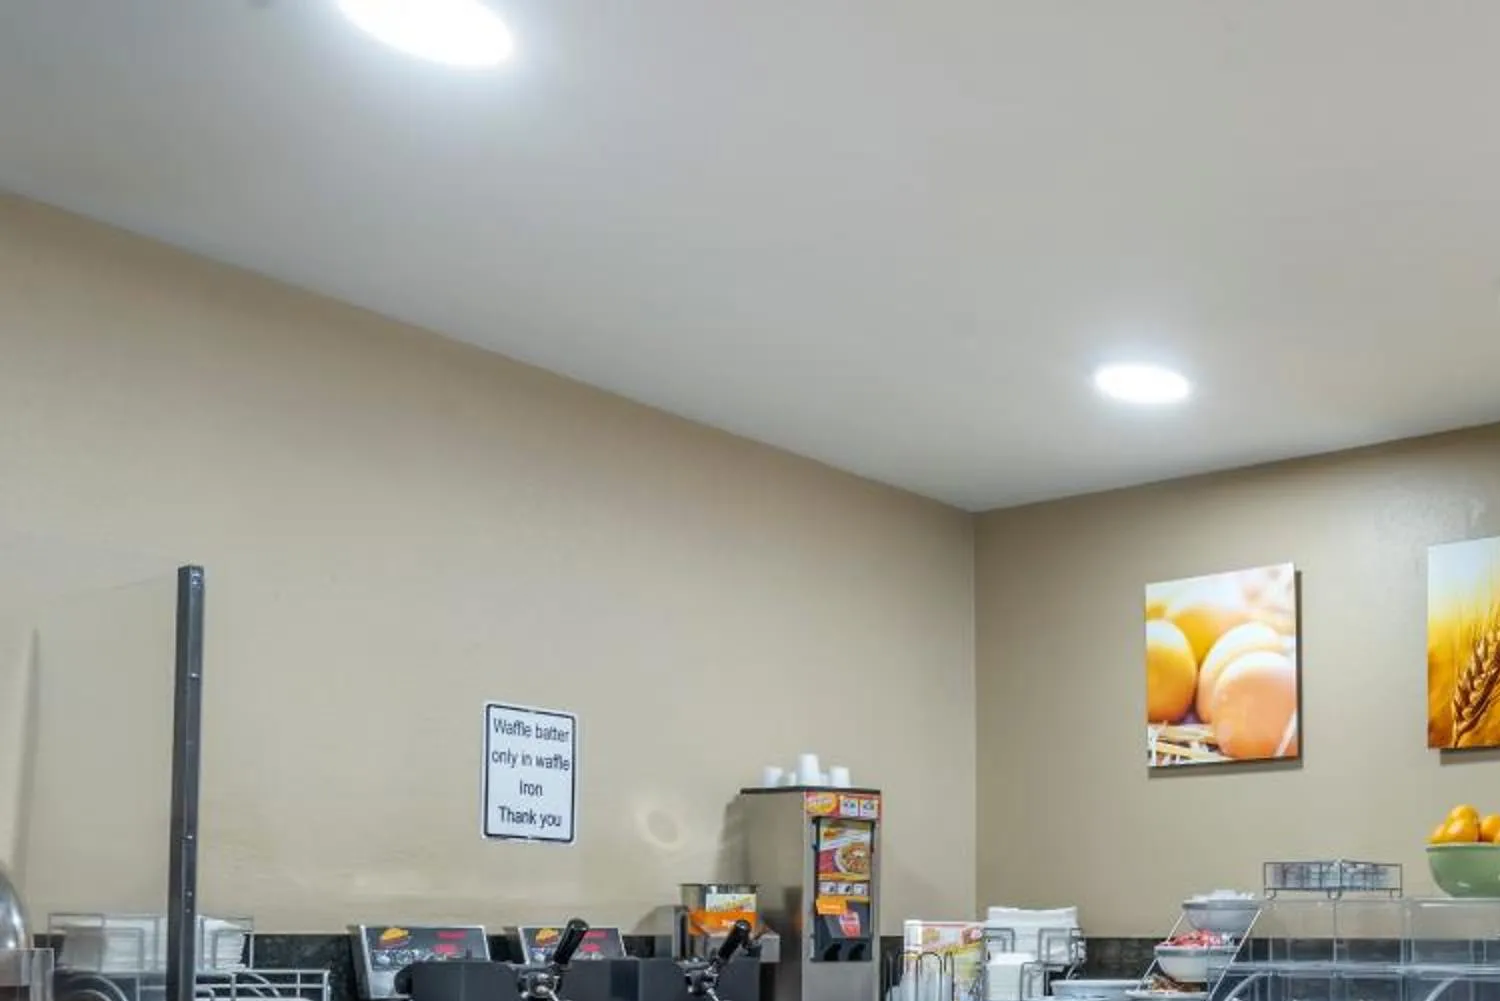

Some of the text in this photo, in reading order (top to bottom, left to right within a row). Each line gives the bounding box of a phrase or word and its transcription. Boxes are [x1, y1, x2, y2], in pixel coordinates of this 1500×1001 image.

[493, 718, 570, 743] Waffle batter
[491, 748, 570, 771] only in waffle
[519, 779, 543, 796] Iron
[498, 806, 562, 829] Thank you
